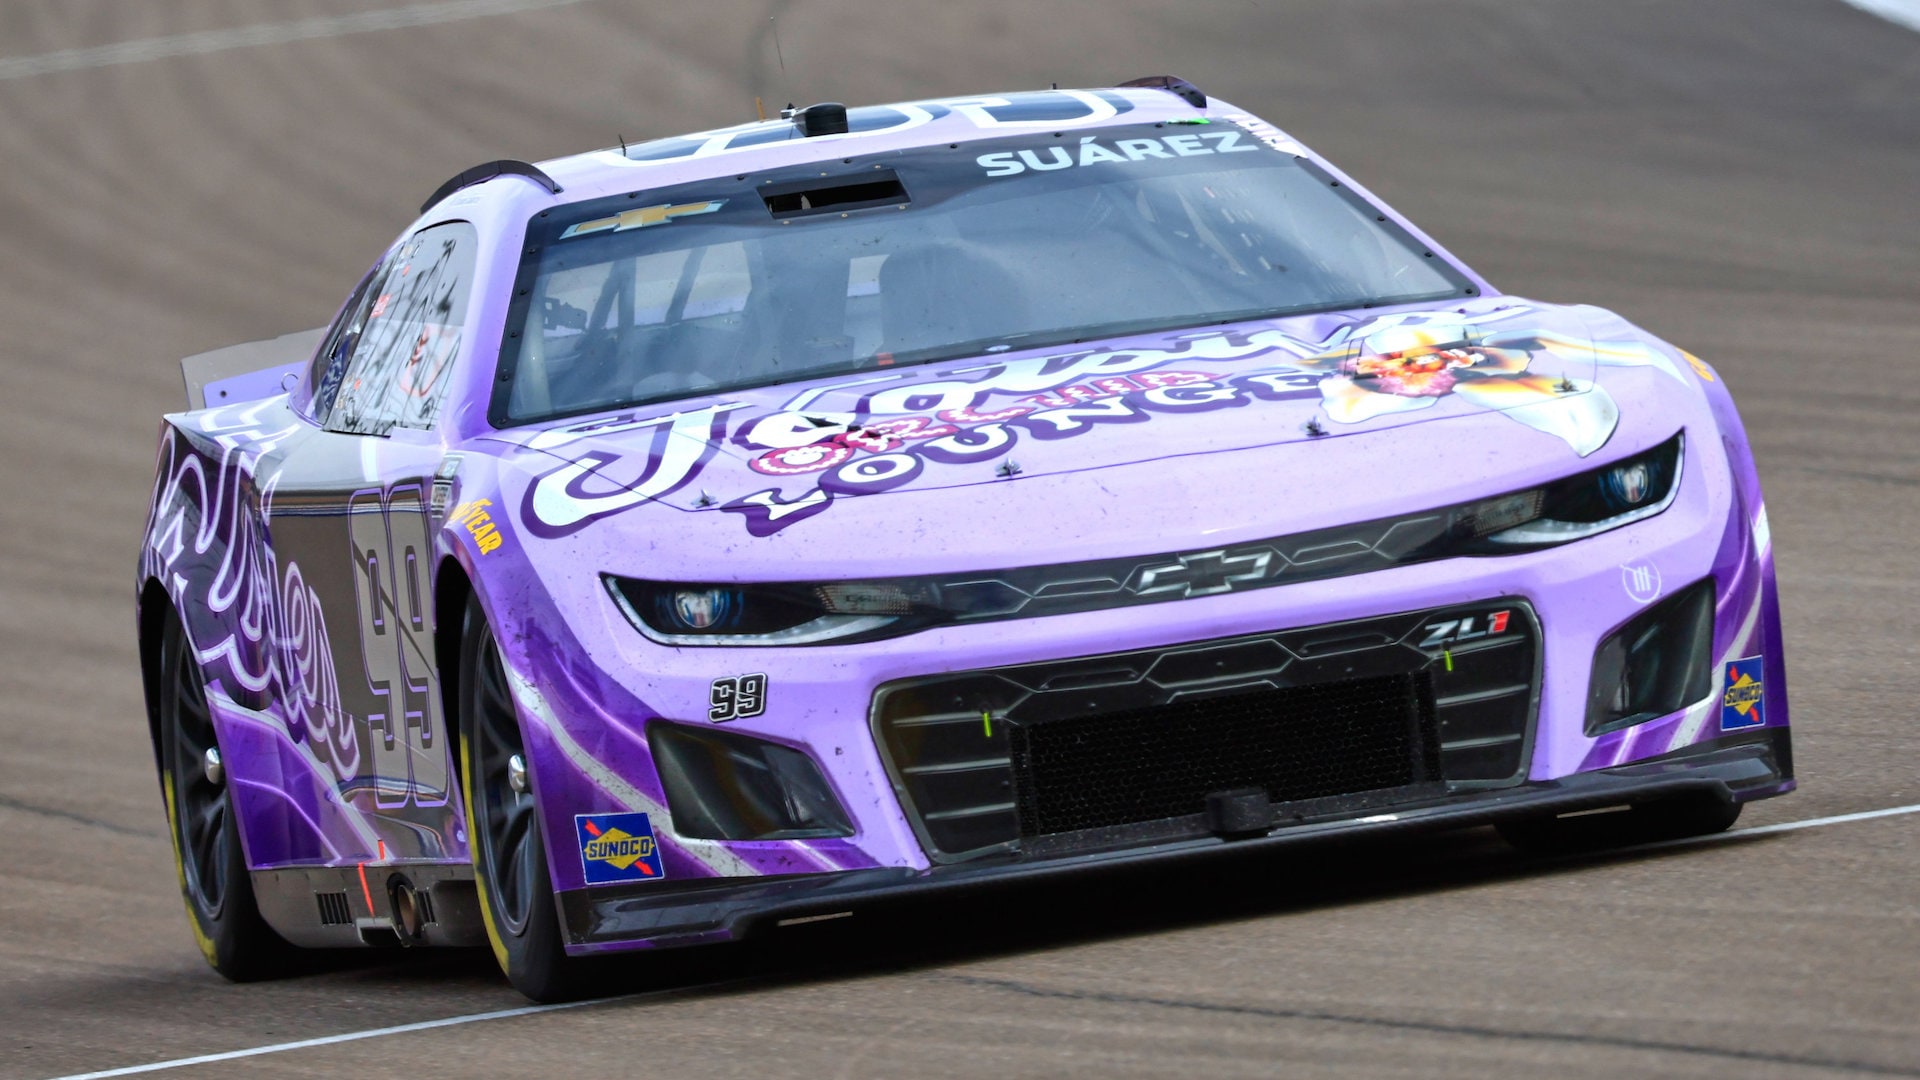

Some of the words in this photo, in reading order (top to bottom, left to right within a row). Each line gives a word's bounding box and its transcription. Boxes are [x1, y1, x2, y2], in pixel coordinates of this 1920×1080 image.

[976, 130, 1260, 177] SUÁREZ
[722, 366, 1332, 538] LOUNGE
[347, 484, 450, 809] 99
[1418, 609, 1511, 648] ZL1
[708, 673, 768, 723] 99
[588, 838, 650, 858] SUNOCO
